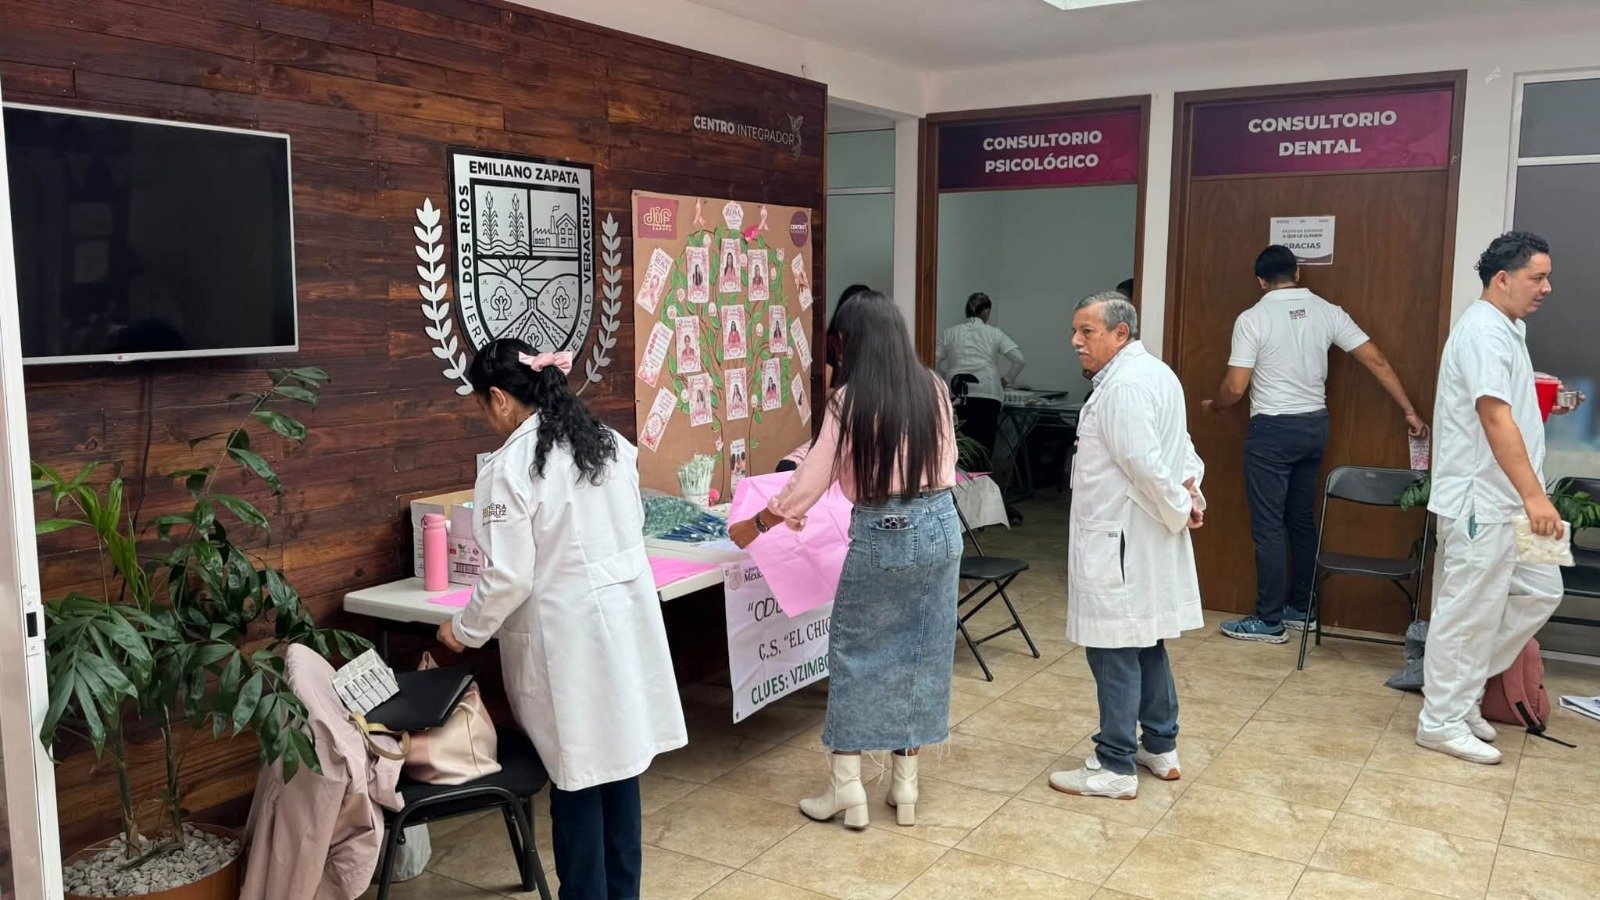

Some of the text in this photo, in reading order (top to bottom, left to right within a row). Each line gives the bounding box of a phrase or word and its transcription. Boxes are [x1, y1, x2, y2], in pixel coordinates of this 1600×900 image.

[693, 115, 795, 145] CENTRO INTEGRADOR
[1248, 110, 1397, 133] CONSULTORIO
[982, 130, 1102, 151] CONSULTORIO
[1278, 138, 1361, 156] DENTAL
[469, 161, 580, 185] EMILIANO ZAPATA
[985, 153, 1099, 173] PSICOLÓGICO
[643, 206, 672, 226] dif
[457, 185, 473, 284] DOS RÍOS
[580, 195, 591, 284] VERACRUZ
[463, 293, 489, 350] TIERR
[571, 293, 591, 350] ERTAD
[758, 639, 781, 661] C.S.
[783, 628, 804, 649] “EL
[751, 673, 789, 705] CLUES:
